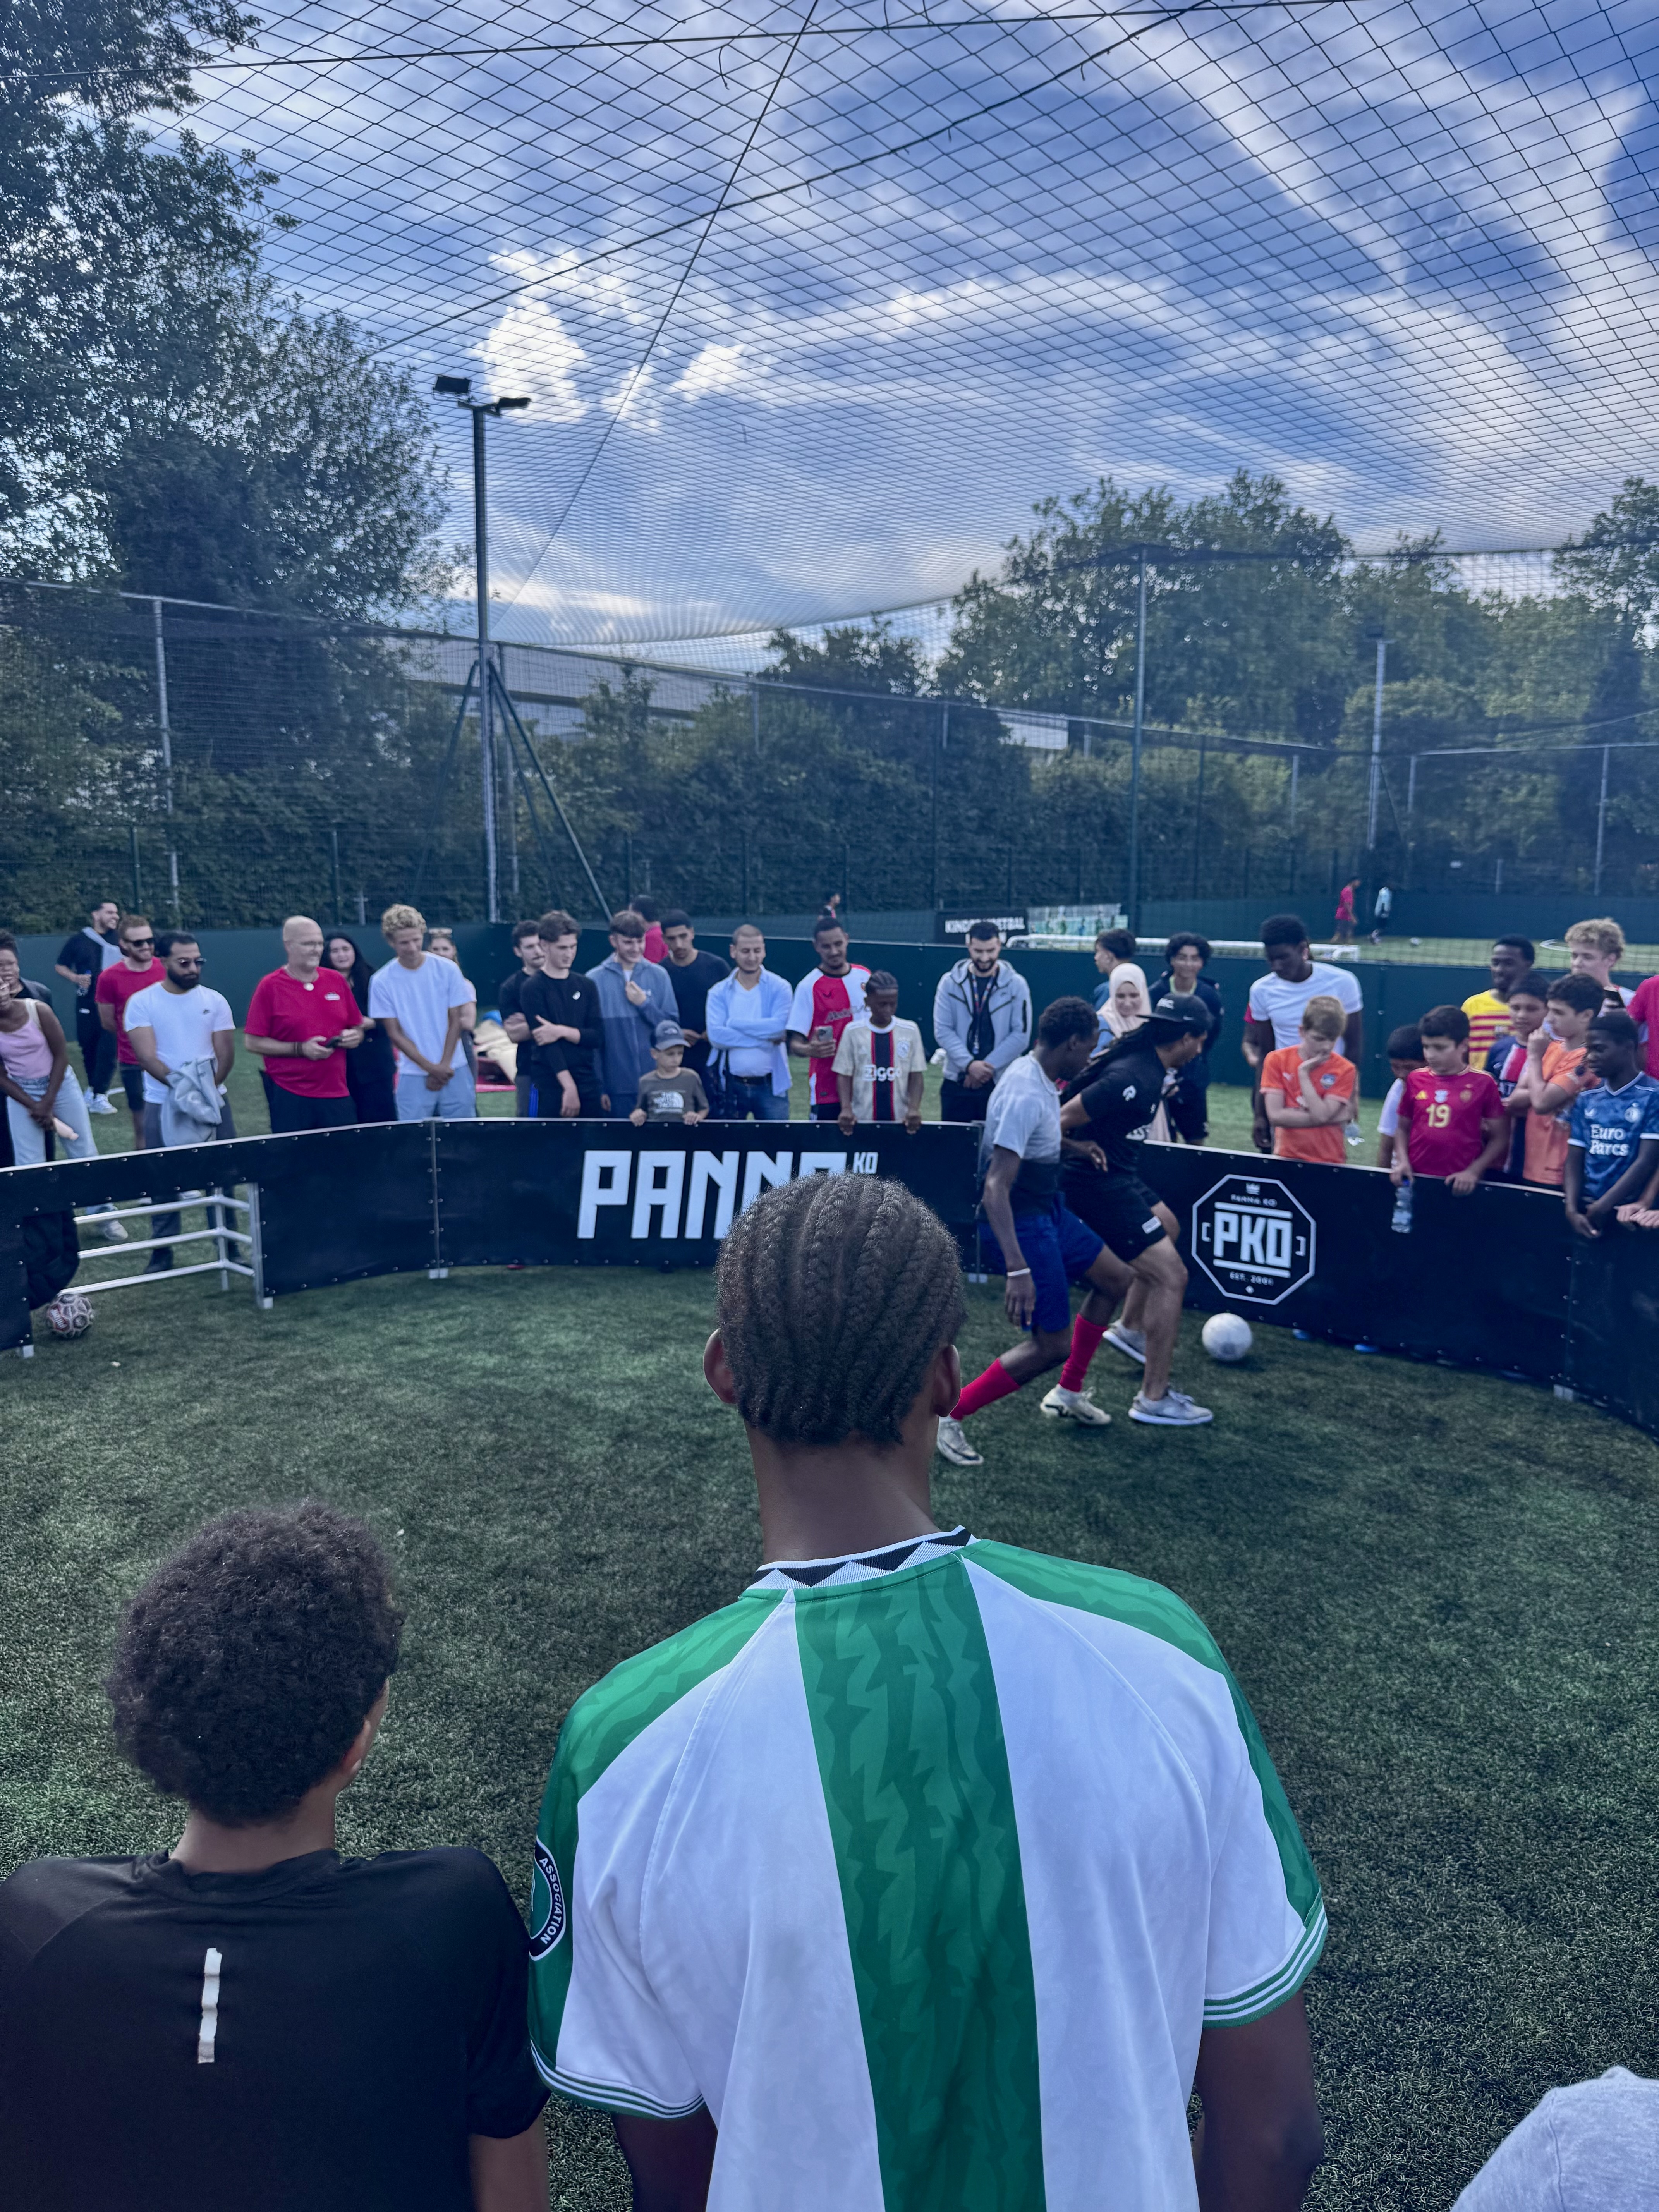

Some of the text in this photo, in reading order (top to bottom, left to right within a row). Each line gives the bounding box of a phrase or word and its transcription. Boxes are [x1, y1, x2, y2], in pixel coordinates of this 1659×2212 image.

[1426, 1103, 1451, 1128] 19
[1590, 1123, 1626, 1140] Euro
[1589, 1139, 1630, 1156] Parcs
[853, 1152, 878, 1174] KO
[1213, 1211, 1293, 1269] PKO
[539, 1857, 562, 1944] ASSOCIATION
